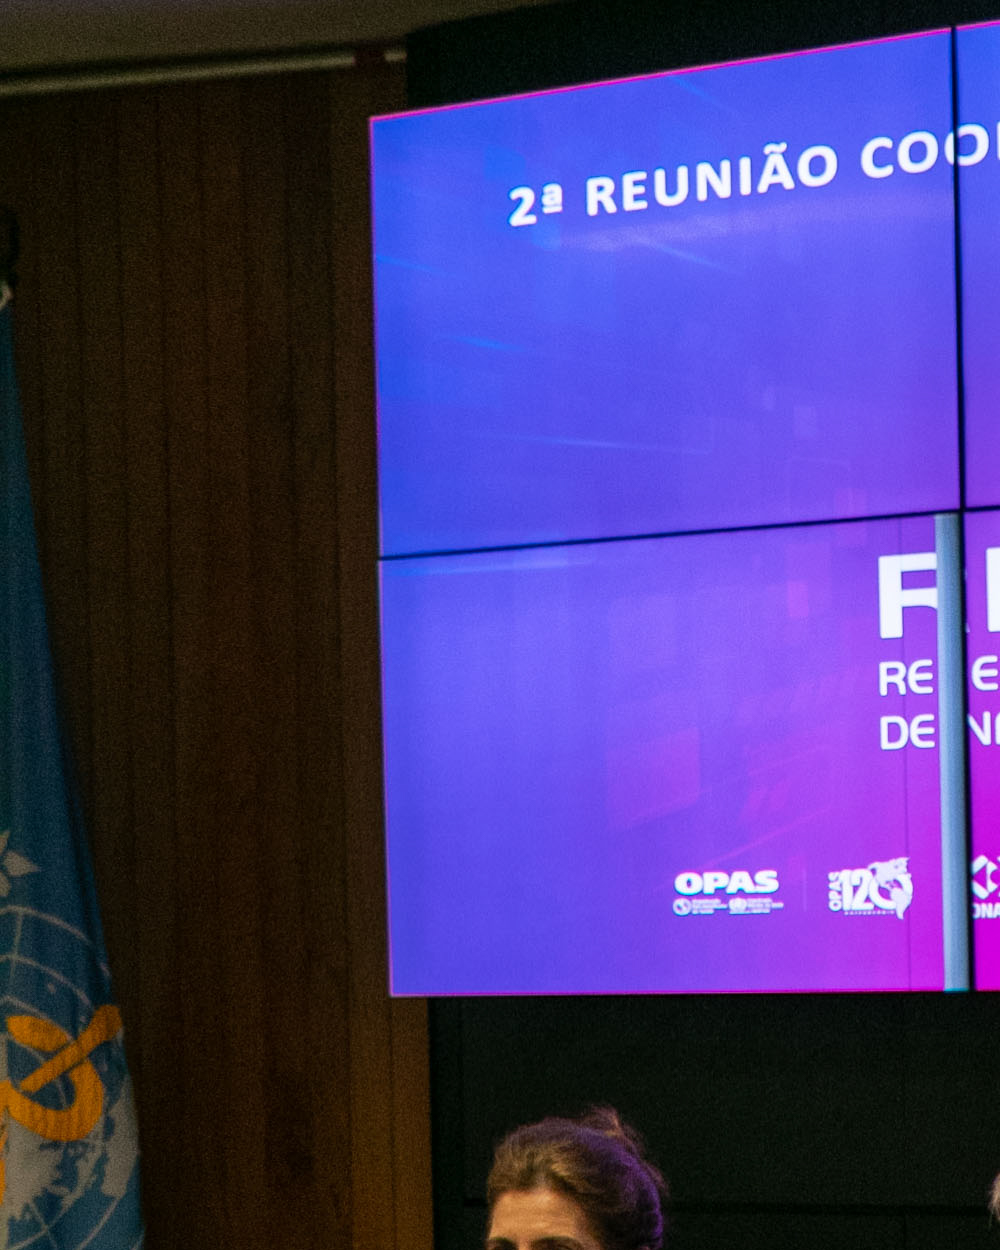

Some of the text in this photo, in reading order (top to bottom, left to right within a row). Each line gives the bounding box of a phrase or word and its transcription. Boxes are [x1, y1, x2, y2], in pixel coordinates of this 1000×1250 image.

[509, 183, 563, 227] 2ª
[586, 142, 838, 217] REUNIÃO
[878, 655, 999, 697] REE
[879, 713, 936, 750] DE
[674, 870, 780, 896] OPAS
